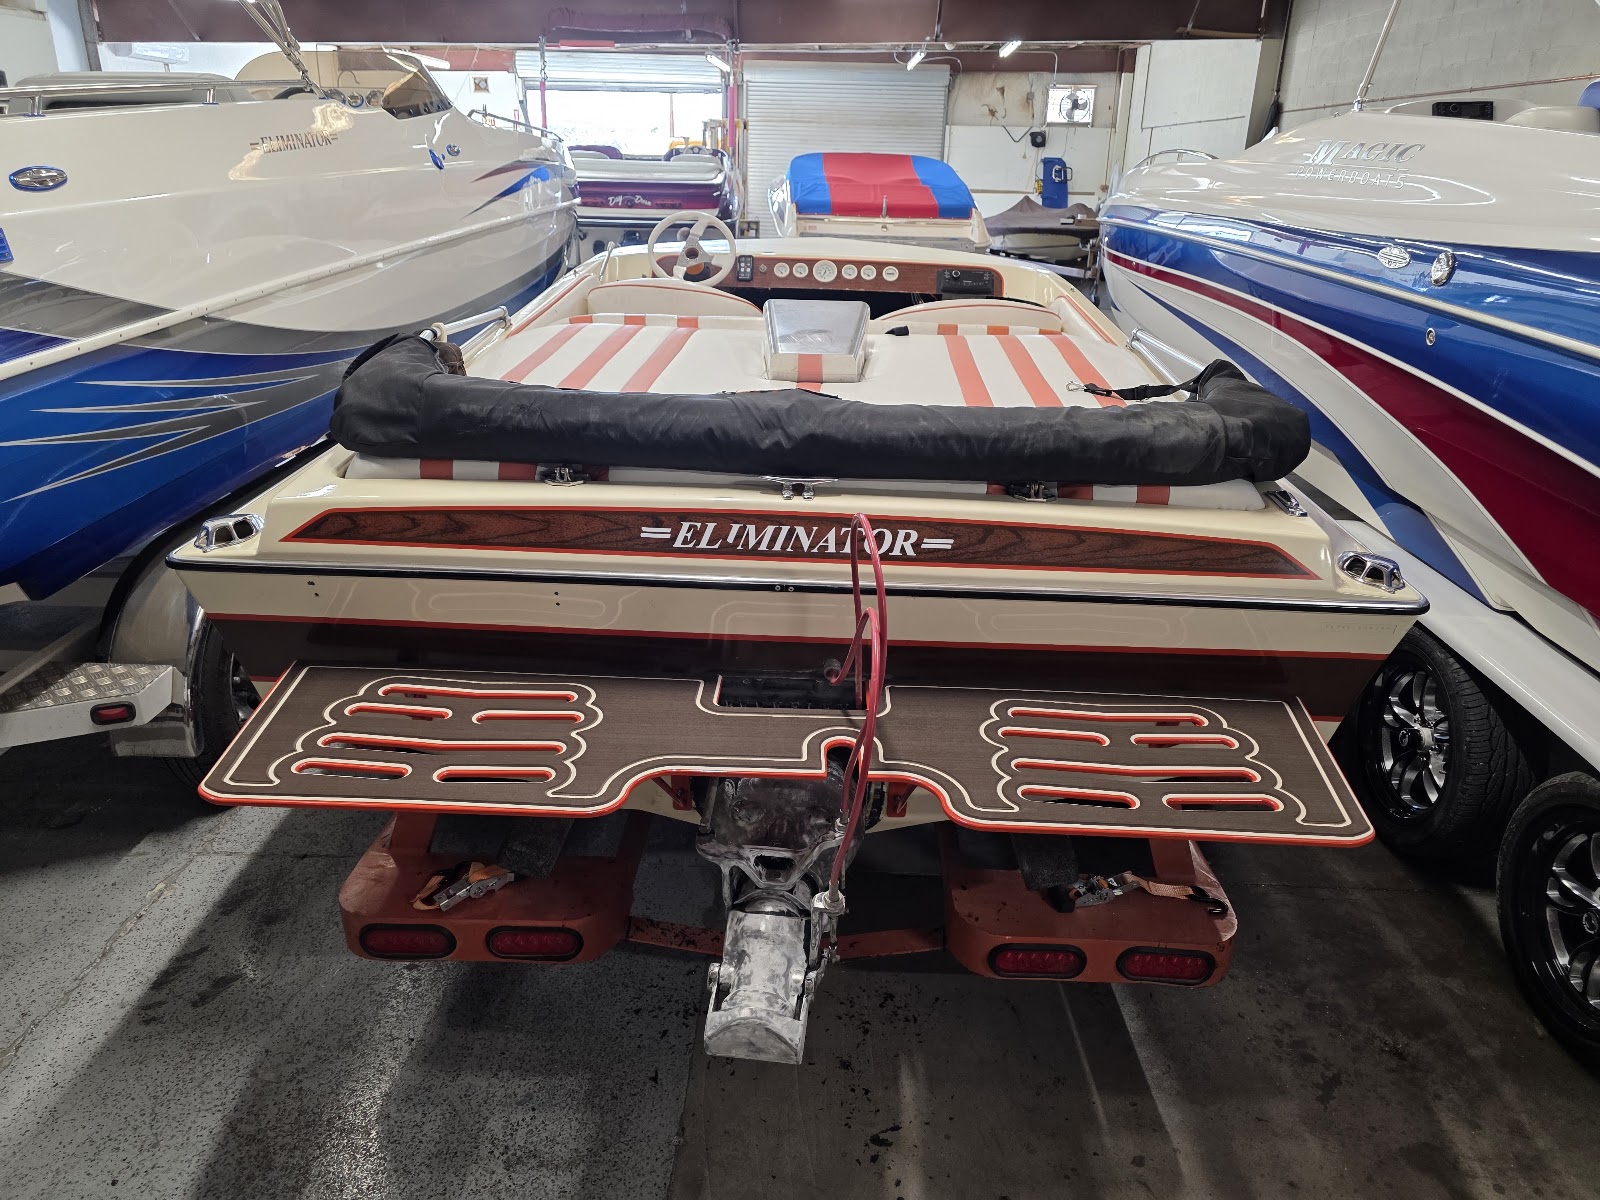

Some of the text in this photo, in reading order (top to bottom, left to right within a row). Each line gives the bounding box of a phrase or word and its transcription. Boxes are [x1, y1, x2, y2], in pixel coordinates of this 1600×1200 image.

[260, 130, 332, 154] ELIMINATOR
[1302, 139, 1426, 165] MAGIC
[1295, 165, 1407, 189] POWERBOATS
